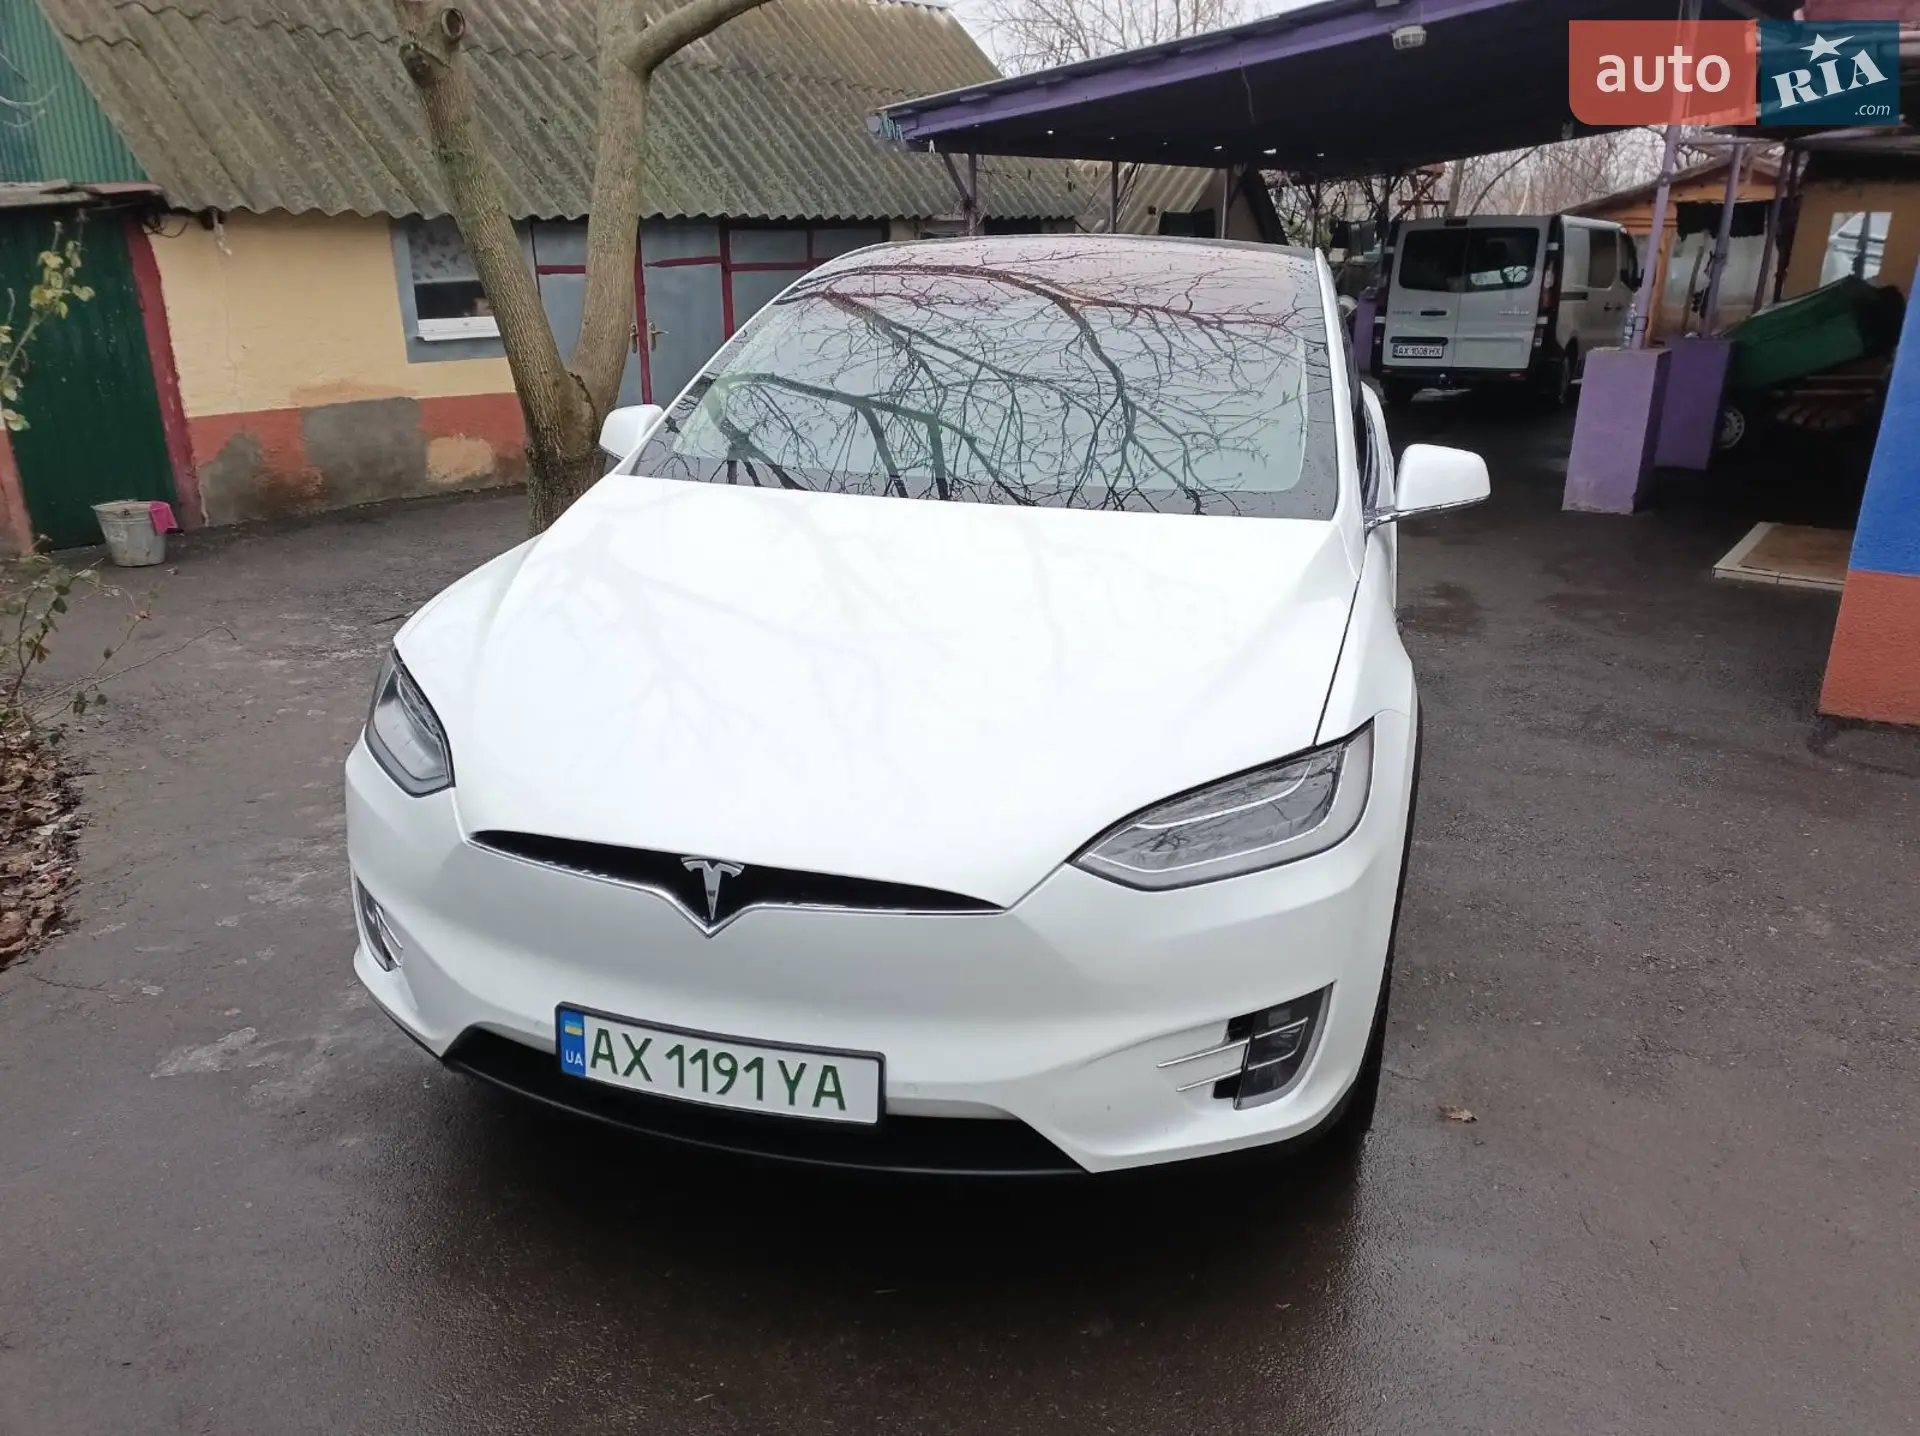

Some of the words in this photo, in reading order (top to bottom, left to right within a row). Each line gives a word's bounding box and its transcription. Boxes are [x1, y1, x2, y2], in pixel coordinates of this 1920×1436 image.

[565, 1050, 584, 1067] UA
[590, 1028, 653, 1083] AX
[664, 1044, 765, 1102] 1191
[778, 1059, 847, 1112] YA
